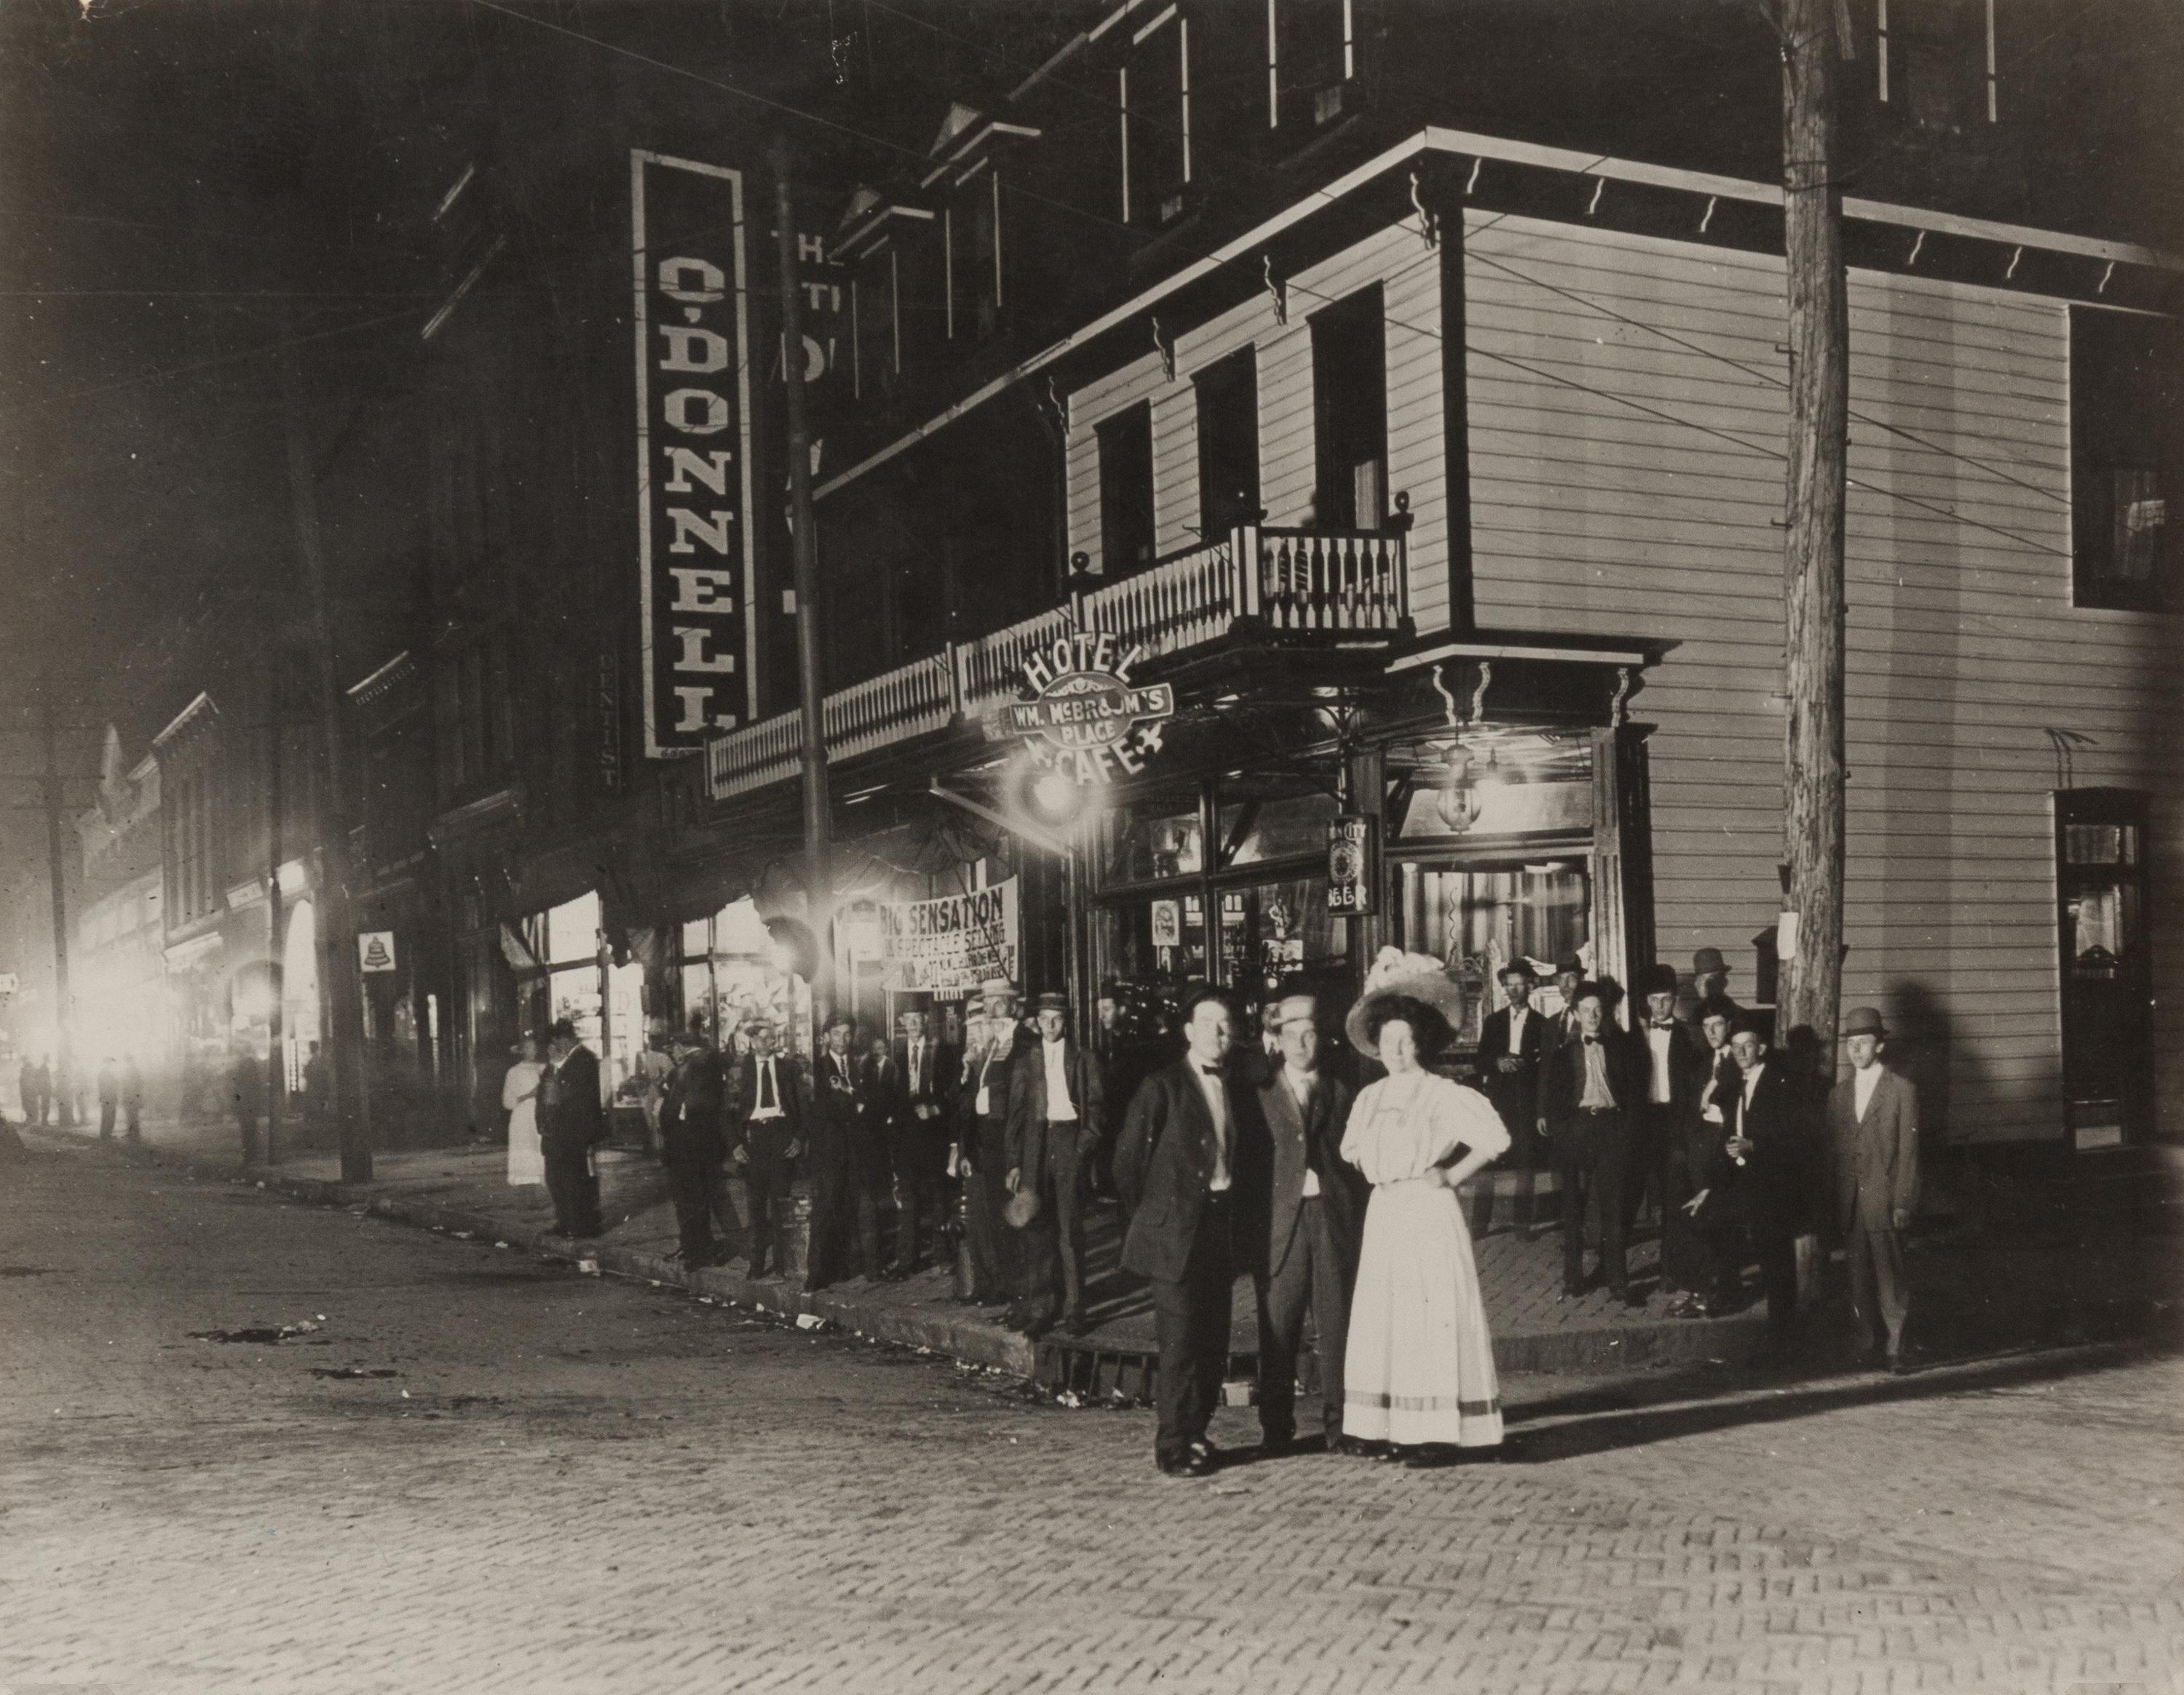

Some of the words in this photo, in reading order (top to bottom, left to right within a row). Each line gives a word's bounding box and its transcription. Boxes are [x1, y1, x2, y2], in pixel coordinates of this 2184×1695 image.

[659, 256, 736, 732] O'DONNELL
[1022, 632, 1142, 694] HOTEL
[599, 654, 617, 786] DENTIST
[1013, 705, 1045, 727] WM.
[1061, 720, 1115, 745] PLACE
[1056, 737, 1144, 786] CAFE
[909, 886, 1003, 936] SENSATION
